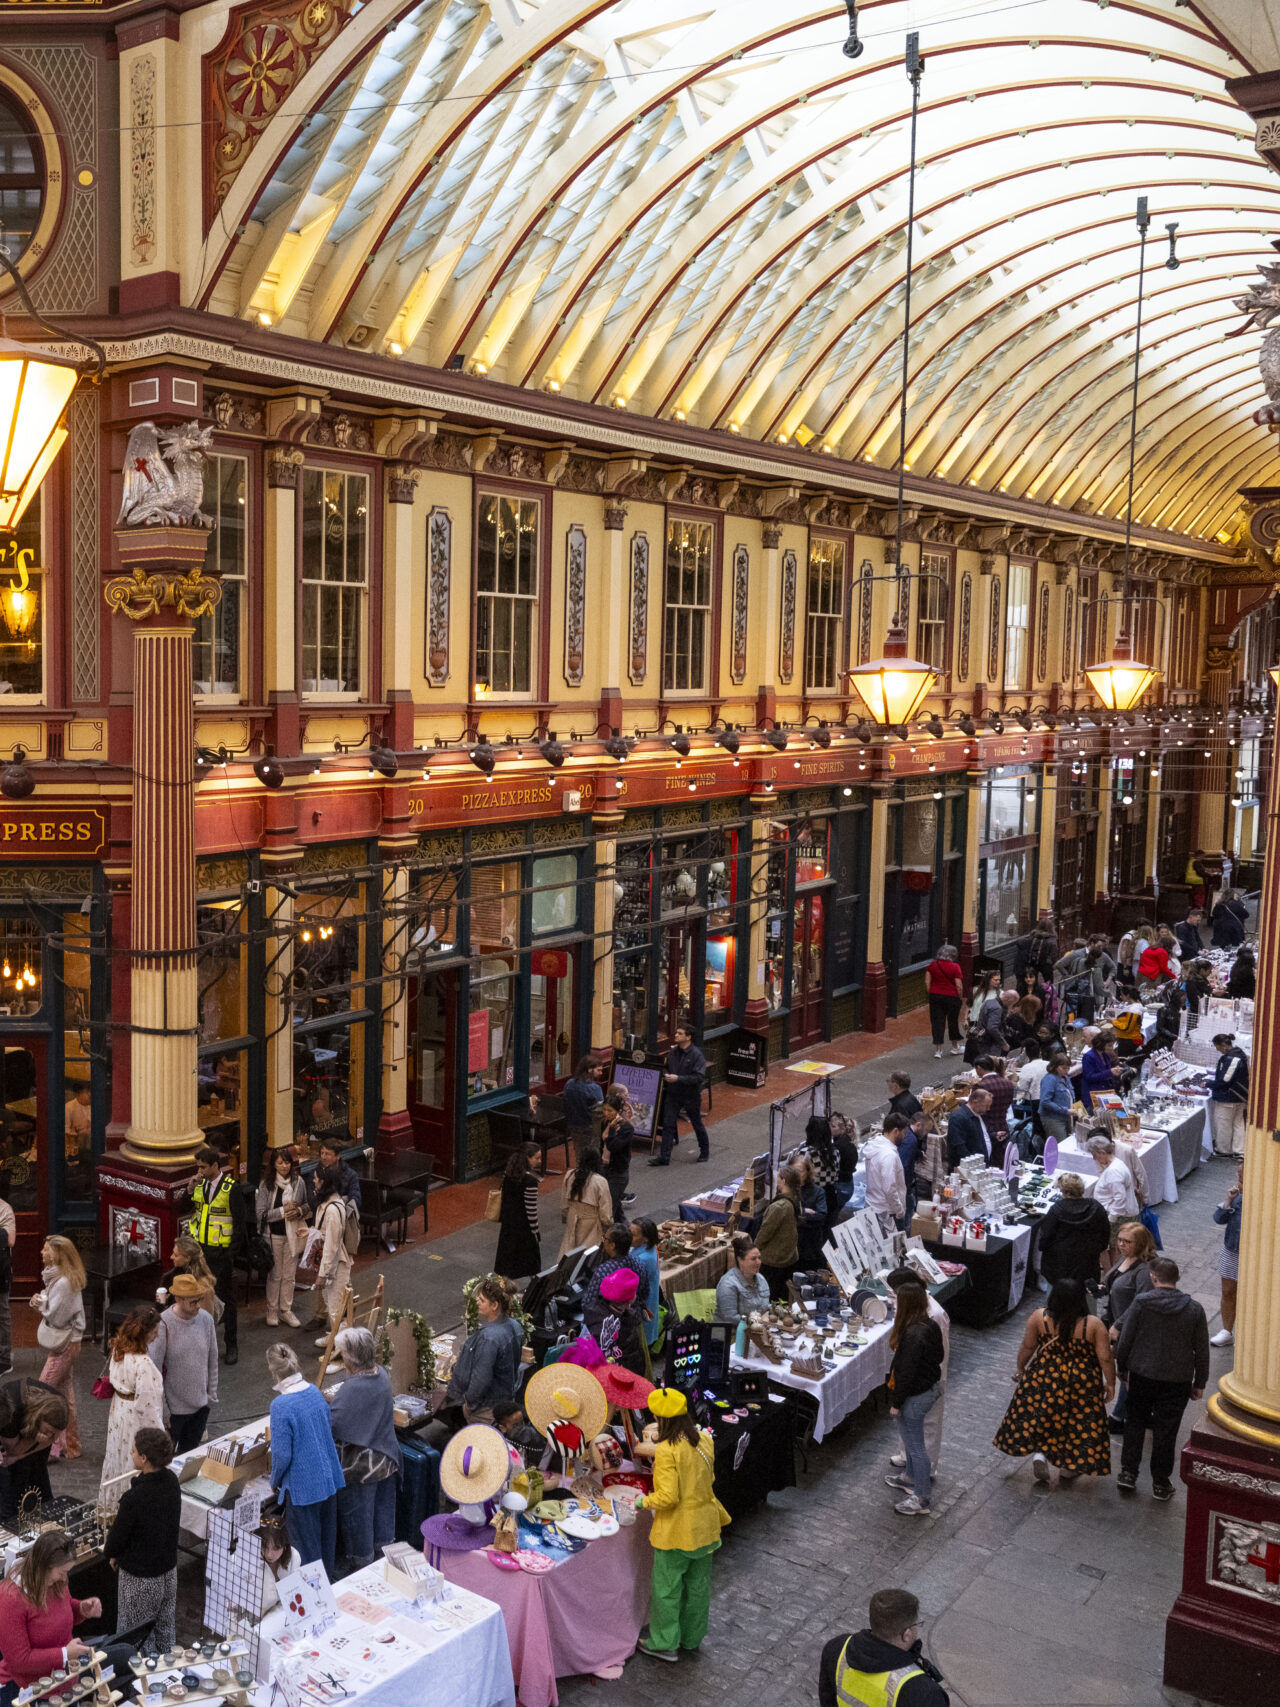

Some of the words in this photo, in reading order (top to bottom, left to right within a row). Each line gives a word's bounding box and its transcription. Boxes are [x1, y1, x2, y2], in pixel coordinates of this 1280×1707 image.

[911, 751, 946, 764] CHAMPAGNE
[801, 763, 818, 775] FINE
[819, 760, 845, 773] SPIRITS
[665, 776, 687, 790] FINE
[408, 799, 424, 815] 20
[462, 787, 552, 810] PIZZAEXPRESS
[578, 783, 592, 799] 20
